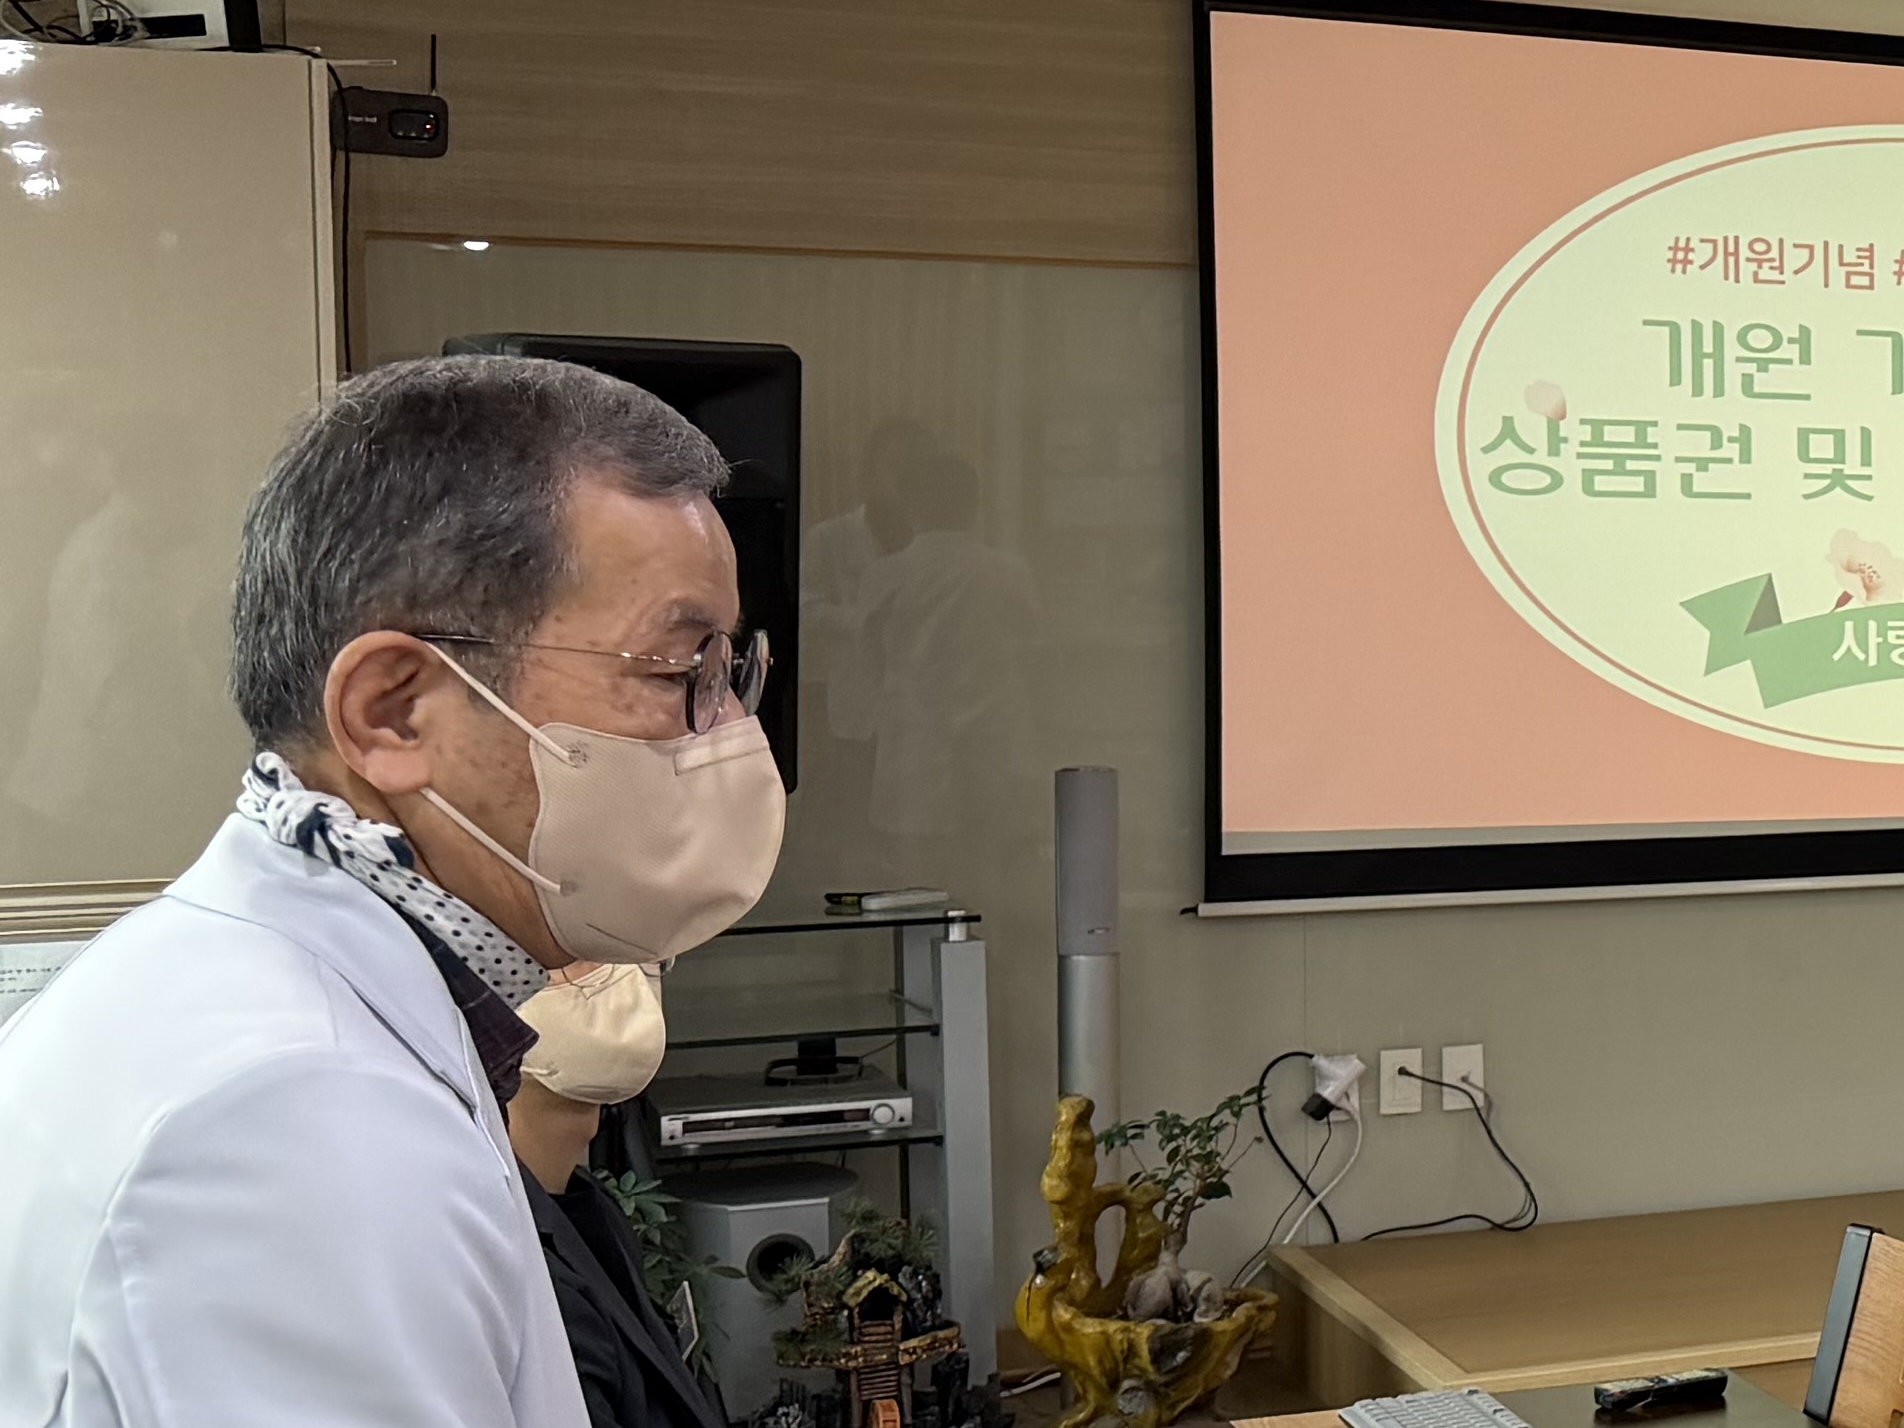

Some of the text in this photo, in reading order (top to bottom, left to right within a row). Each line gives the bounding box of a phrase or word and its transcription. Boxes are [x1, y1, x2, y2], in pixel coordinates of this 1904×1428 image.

[1666, 234, 1876, 292] #개원기념
[1642, 317, 1812, 402] 개원
[1479, 412, 1753, 502] 상품권
[1795, 425, 1875, 504] 및
